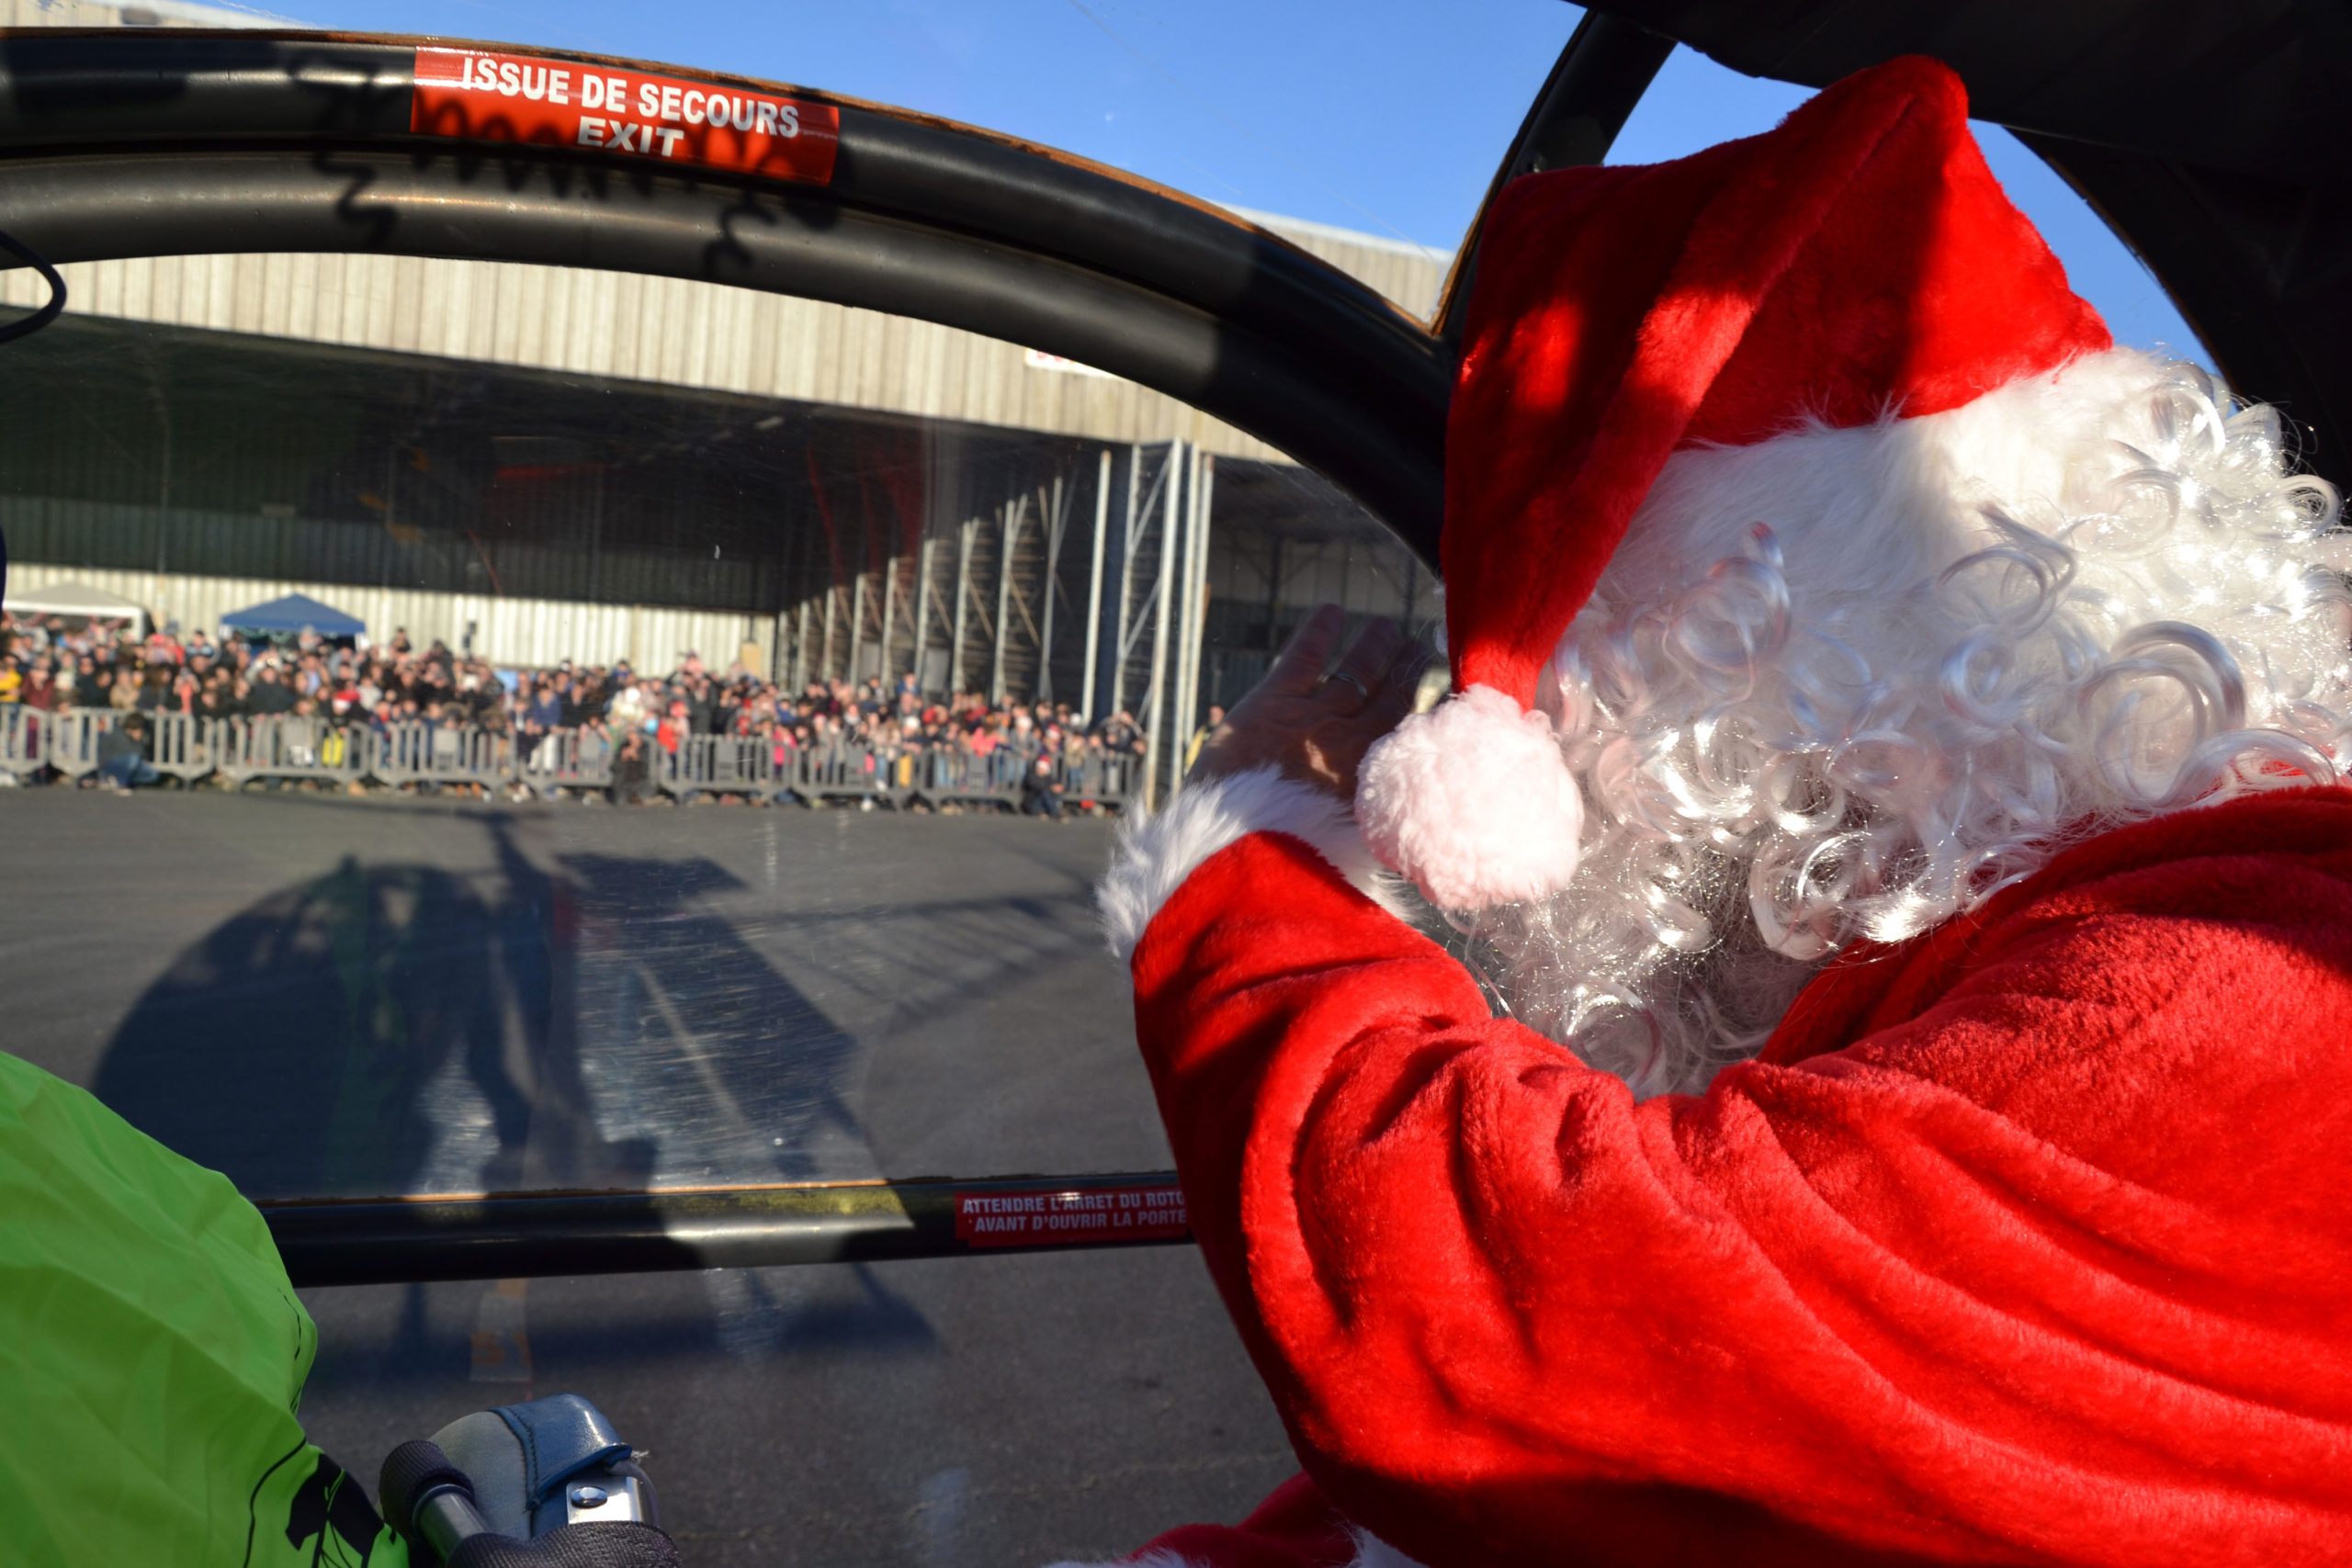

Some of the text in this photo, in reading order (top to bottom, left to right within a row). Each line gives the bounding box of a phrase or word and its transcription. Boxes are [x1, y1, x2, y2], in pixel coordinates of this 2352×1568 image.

[462, 57, 798, 139] ISSUE DE SECOURS
[578, 116, 684, 157] EXIT
[963, 1197, 1045, 1213] ATTENDRE
[1050, 1194, 1114, 1211] L'ARRET
[1120, 1192, 1141, 1208] DU
[975, 1209, 1187, 1232] AVANT D'OUVRIR LA PORTE
